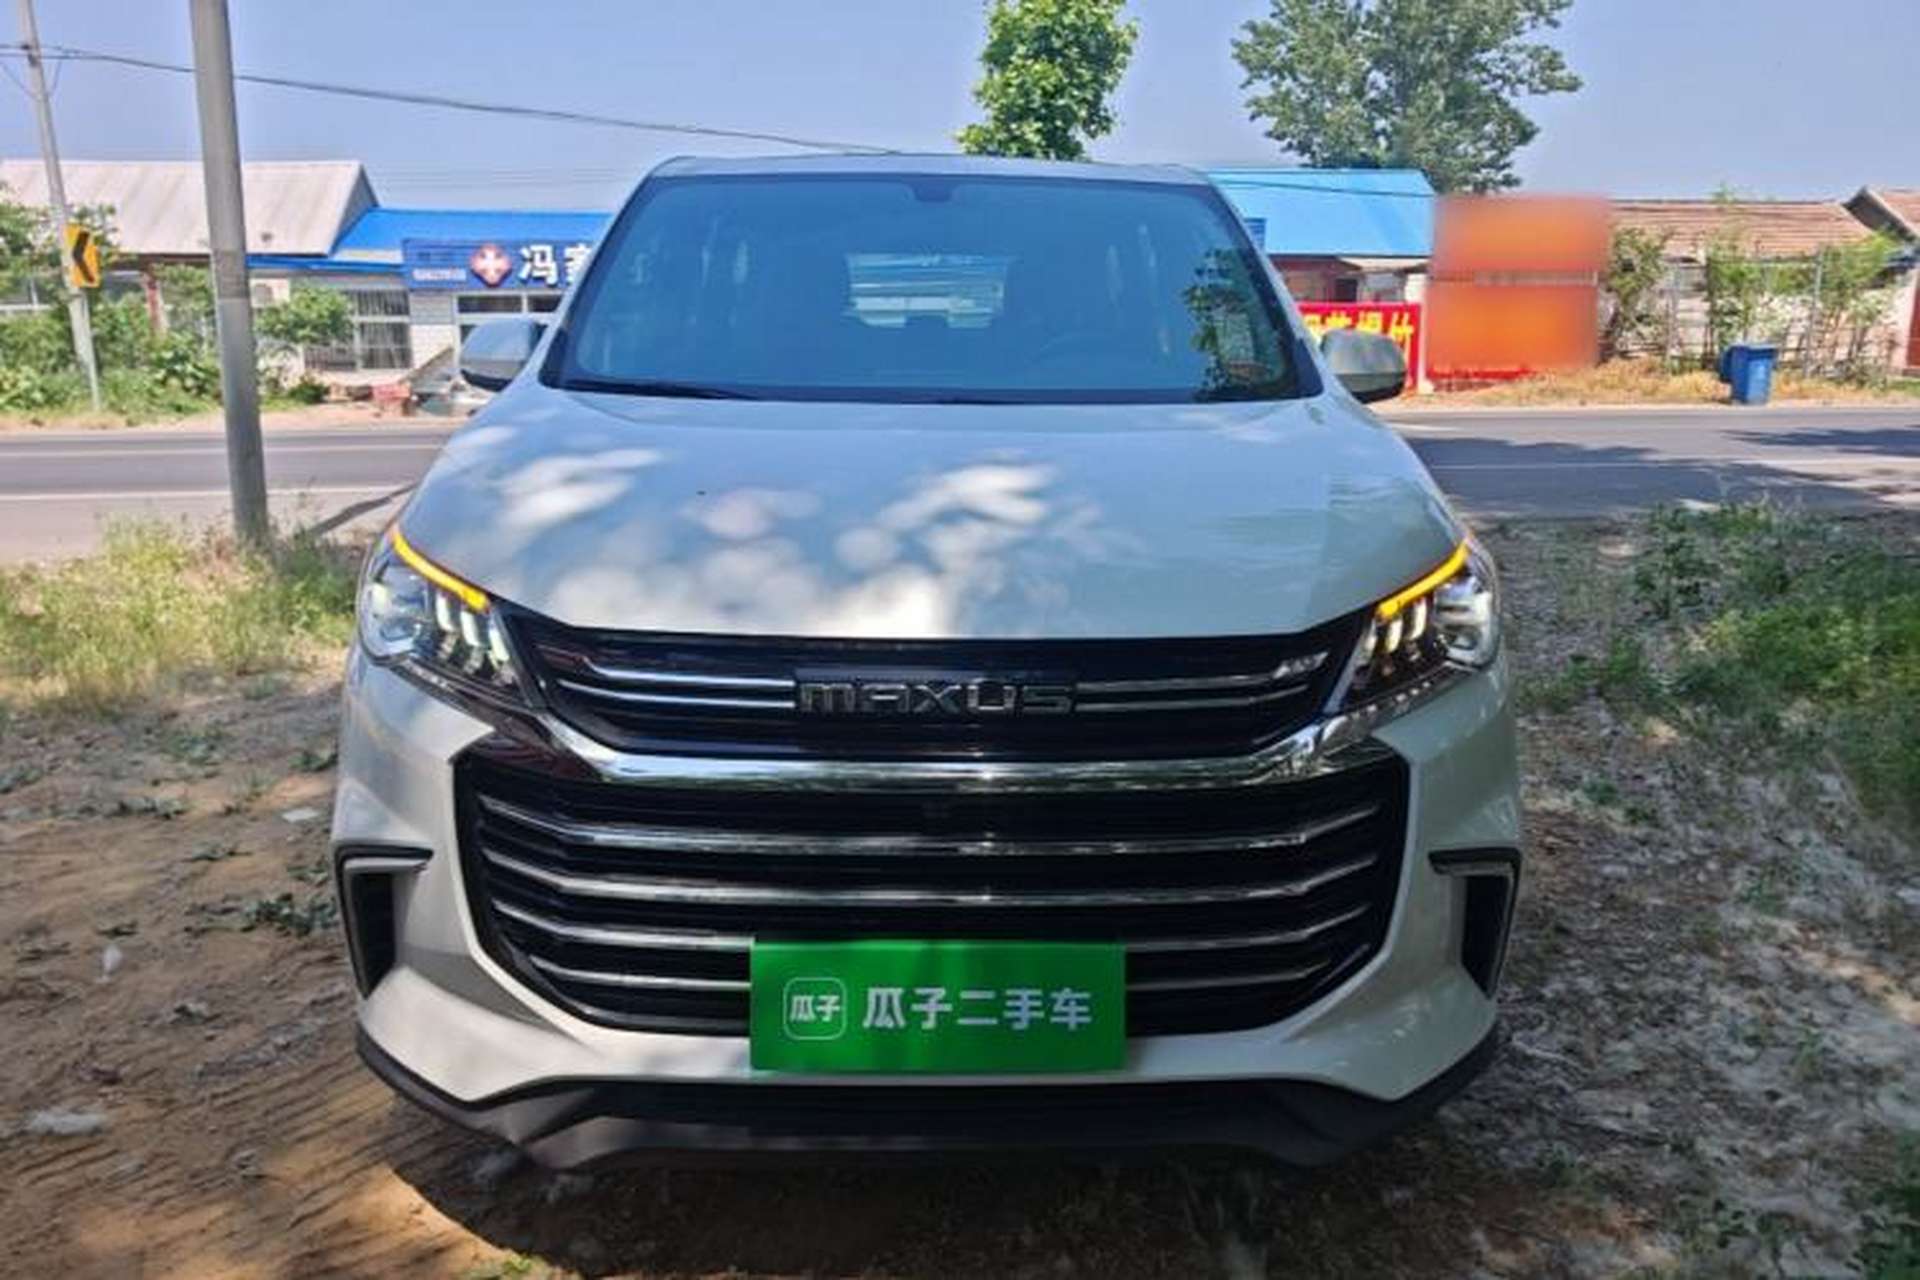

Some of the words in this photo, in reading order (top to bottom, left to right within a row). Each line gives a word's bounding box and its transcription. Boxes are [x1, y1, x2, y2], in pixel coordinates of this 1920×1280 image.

[799, 682, 1072, 713] MAXUS
[789, 994, 841, 1022] 瓜子
[862, 986, 1092, 1030] 瓜子二手车
